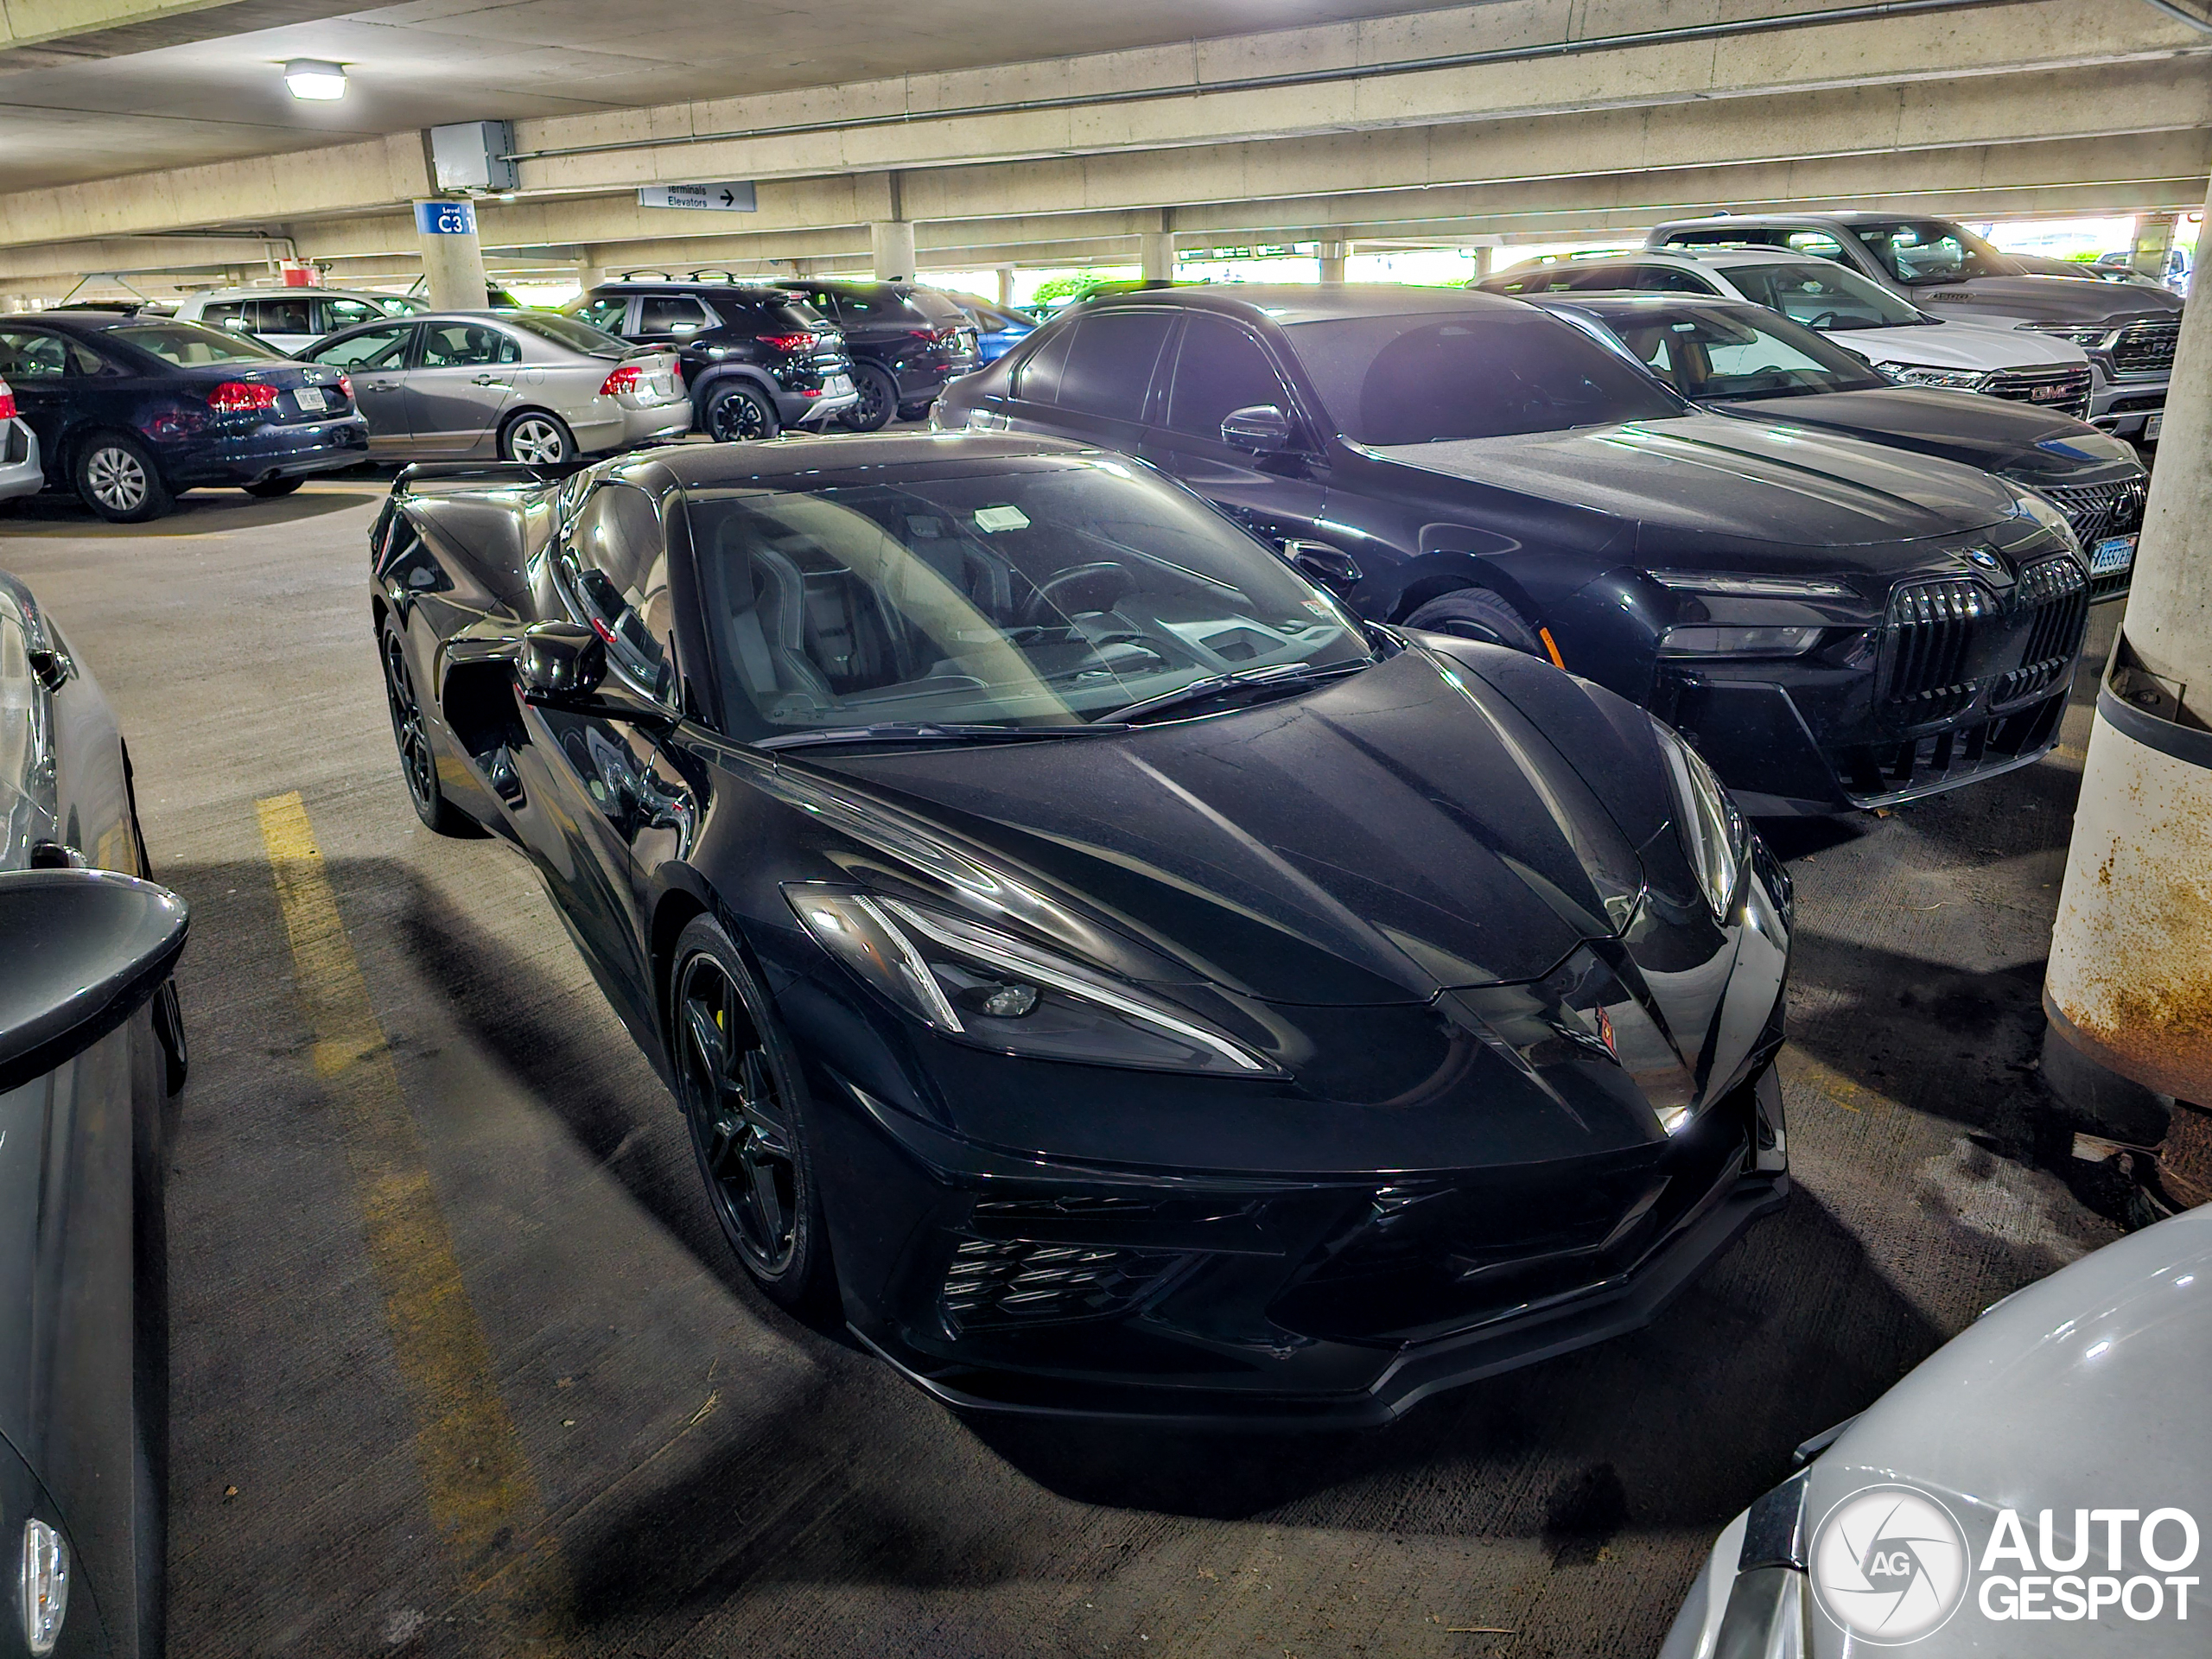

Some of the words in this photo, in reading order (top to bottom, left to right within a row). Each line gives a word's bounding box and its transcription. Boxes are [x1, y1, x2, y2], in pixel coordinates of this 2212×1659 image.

[668, 185, 707, 196] Terminals
[668, 196, 708, 208] Elevators
[442, 206, 461, 214] Level
[438, 214, 463, 233] C3
[2031, 383, 2075, 402] GMC
